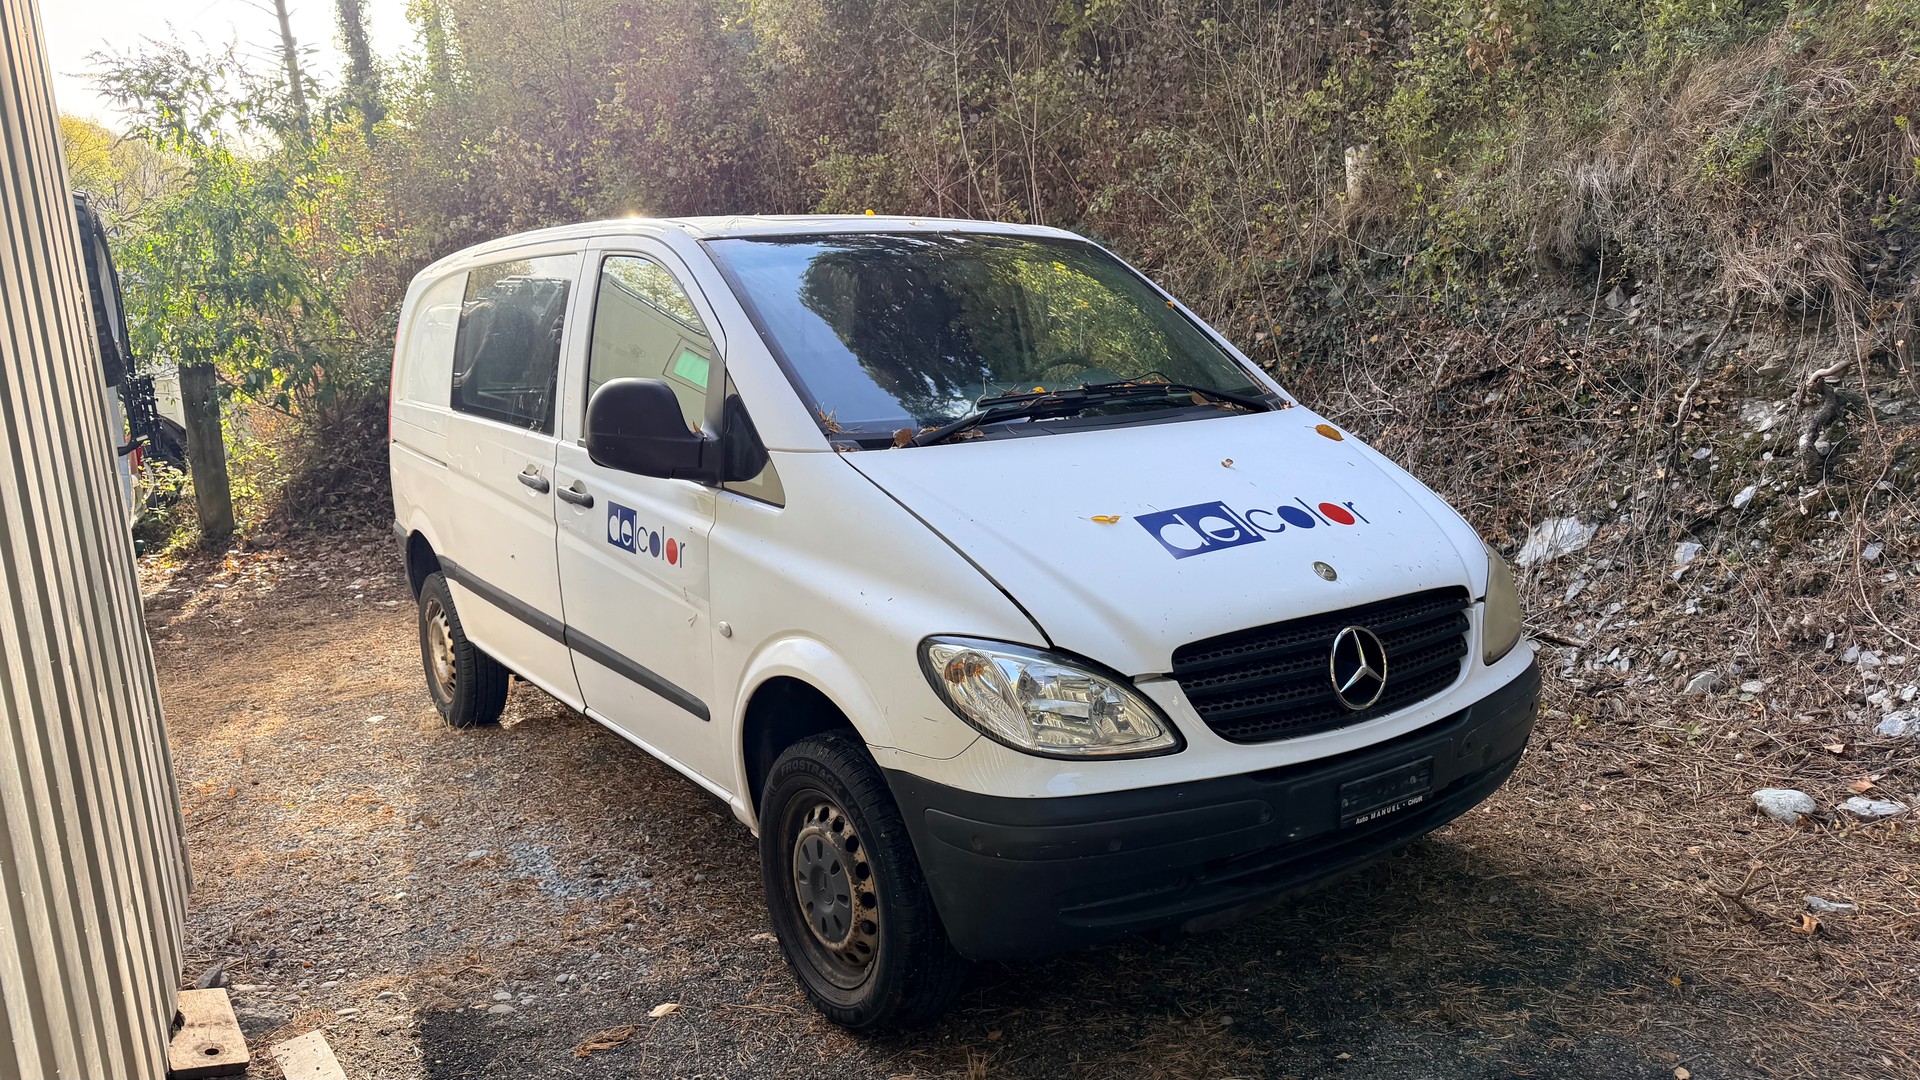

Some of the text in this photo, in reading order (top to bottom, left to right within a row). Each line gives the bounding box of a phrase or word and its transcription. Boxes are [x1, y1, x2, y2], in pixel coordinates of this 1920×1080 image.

[608, 506, 686, 569] delcolor
[1158, 496, 1371, 551] delcolor
[781, 760, 843, 793] FROSTRACK
[1355, 795, 1423, 825] Auto MANUEL CHUR
